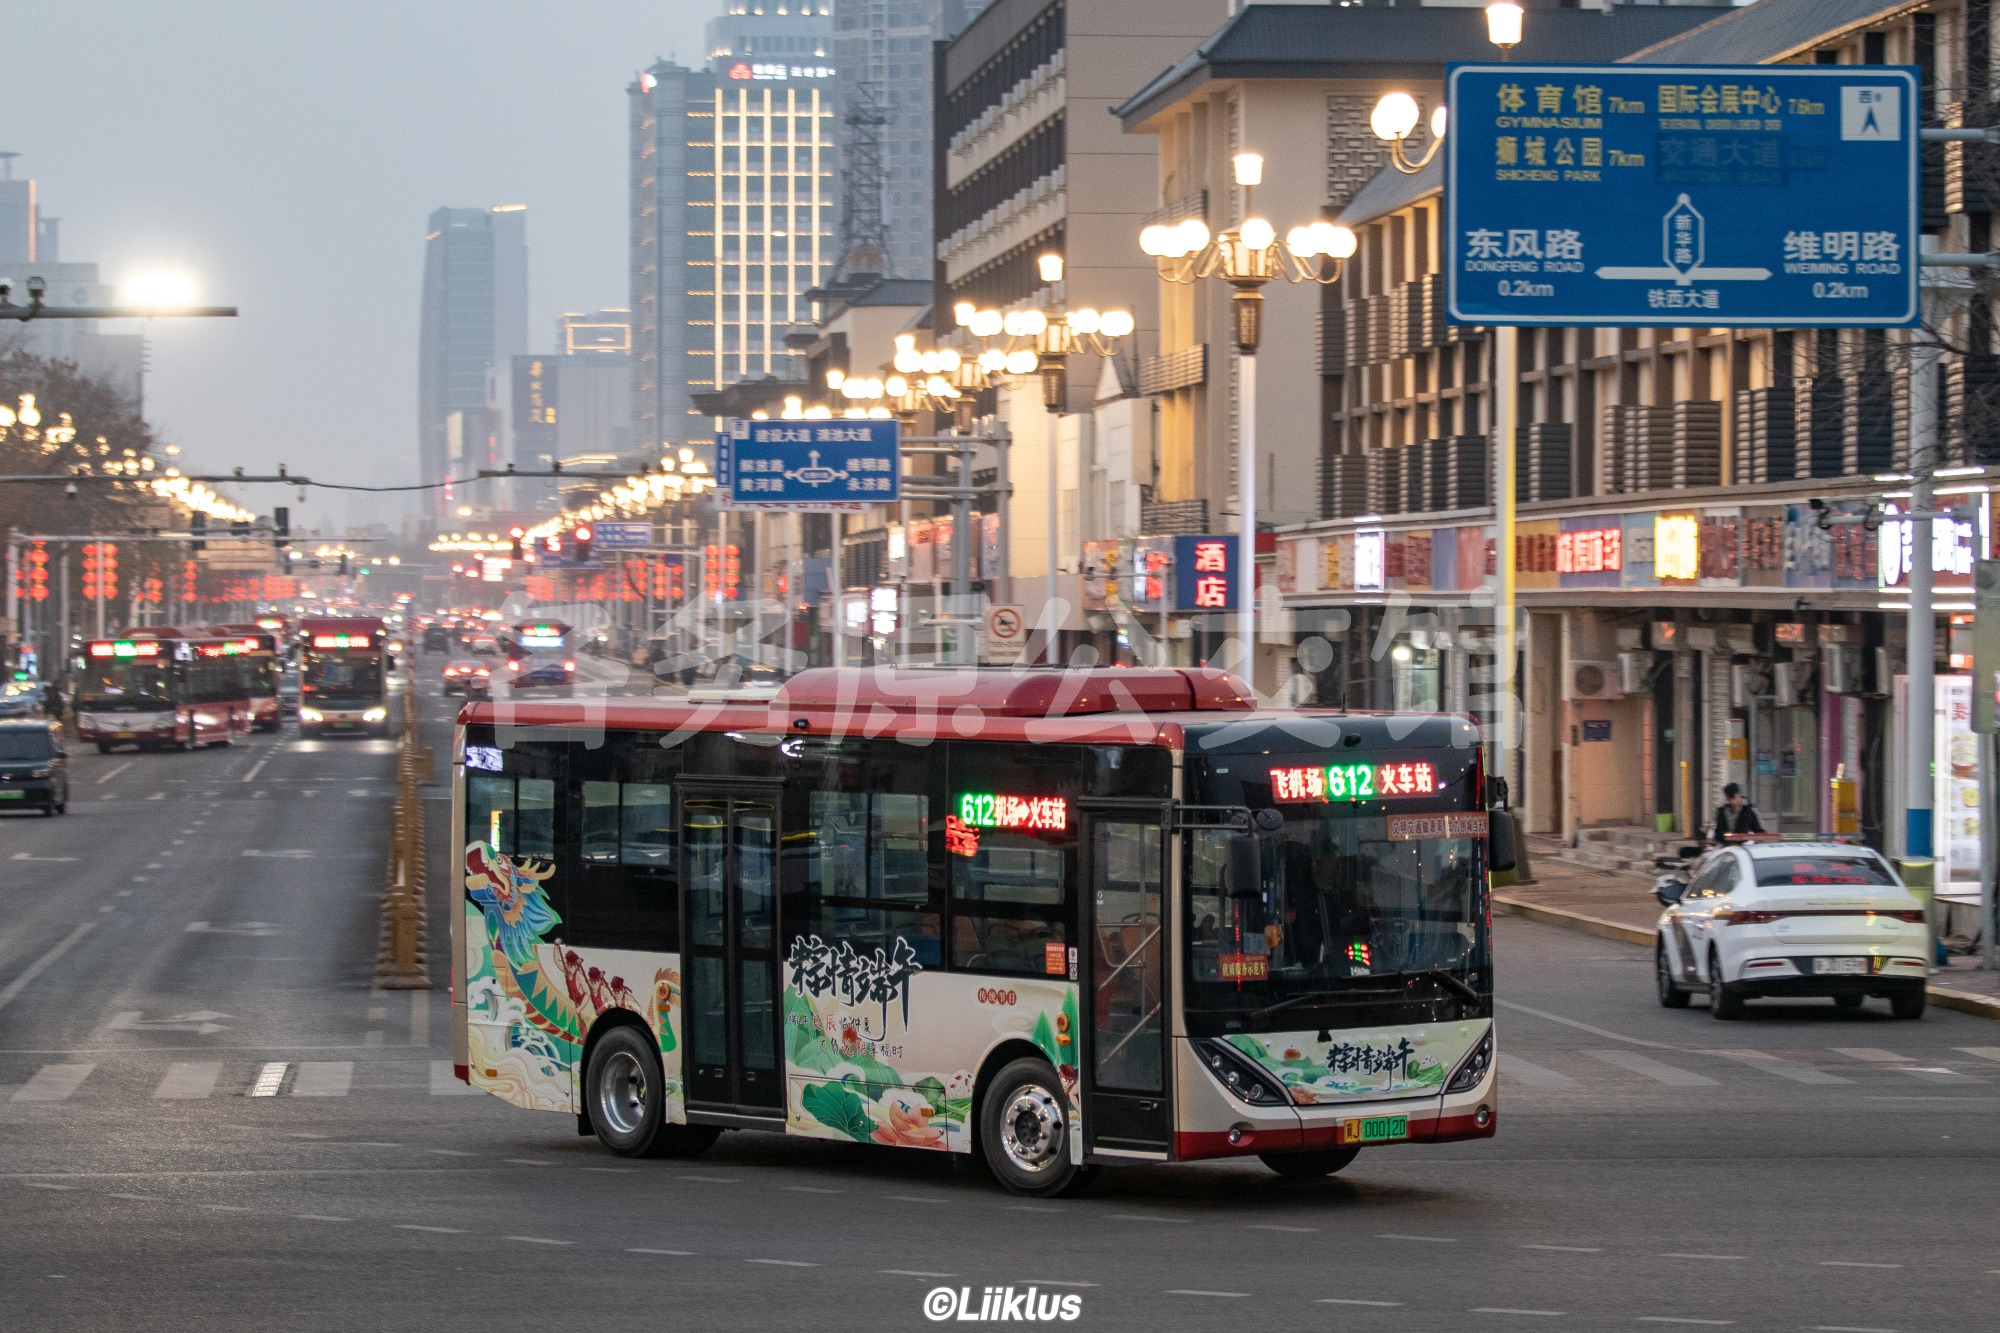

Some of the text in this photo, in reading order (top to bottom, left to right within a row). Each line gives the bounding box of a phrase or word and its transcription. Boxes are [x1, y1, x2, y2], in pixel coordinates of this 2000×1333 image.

[1496, 84, 1645, 114] 体育馆 7km
[1658, 84, 1782, 114] 国际会展中心
[1495, 116, 1603, 129] GYMNASIUM
[1496, 136, 1645, 166] 狮城公园 7km
[1495, 169, 1601, 181] SHICHENG PARK
[1465, 229, 1585, 260] 东风路
[1783, 231, 1900, 261] 维明路
[1465, 260, 1585, 273] DONGFENG ROAD
[1783, 263, 1901, 275] WEIMING ROAD
[1497, 279, 1555, 296] 0.2km
[1647, 288, 1721, 309] 铁西大道
[1812, 282, 1869, 298] 0.2km
[1194, 541, 1228, 608] 酒店
[1270, 763, 1432, 799] 飞机场 612 火车站
[962, 793, 994, 825] 612
[1028, 797, 1066, 829] 火车站
[979, 989, 1016, 1005] 传统节日
